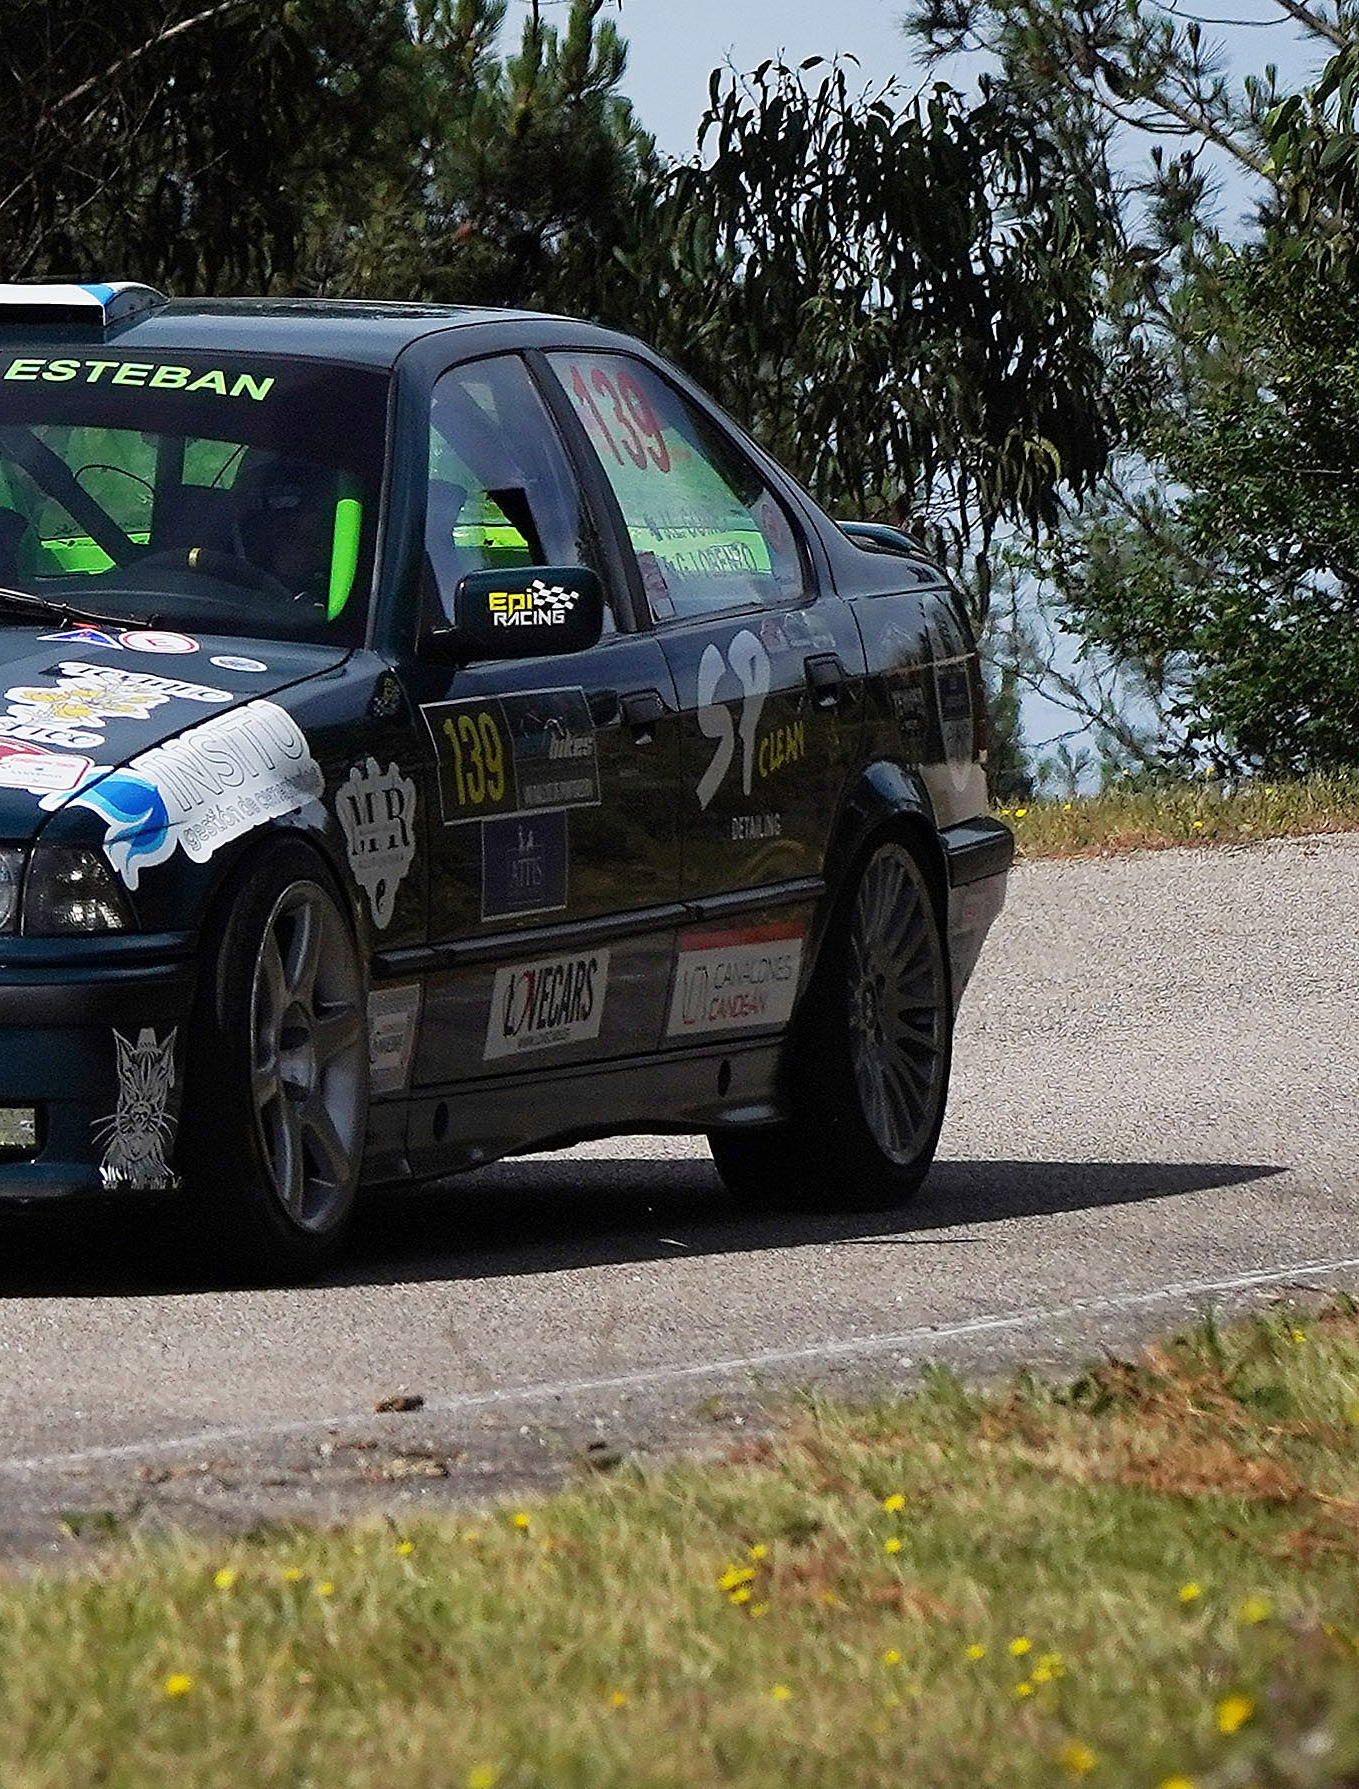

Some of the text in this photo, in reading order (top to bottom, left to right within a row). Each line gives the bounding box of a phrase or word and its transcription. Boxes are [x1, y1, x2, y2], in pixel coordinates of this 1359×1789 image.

[4, 358, 275, 402] ESTEBAN
[570, 365, 670, 473] 139
[493, 609, 566, 626] RACING
[443, 712, 505, 806] 139
[758, 720, 805, 778] CLEAN
[731, 813, 783, 841] DETAILING
